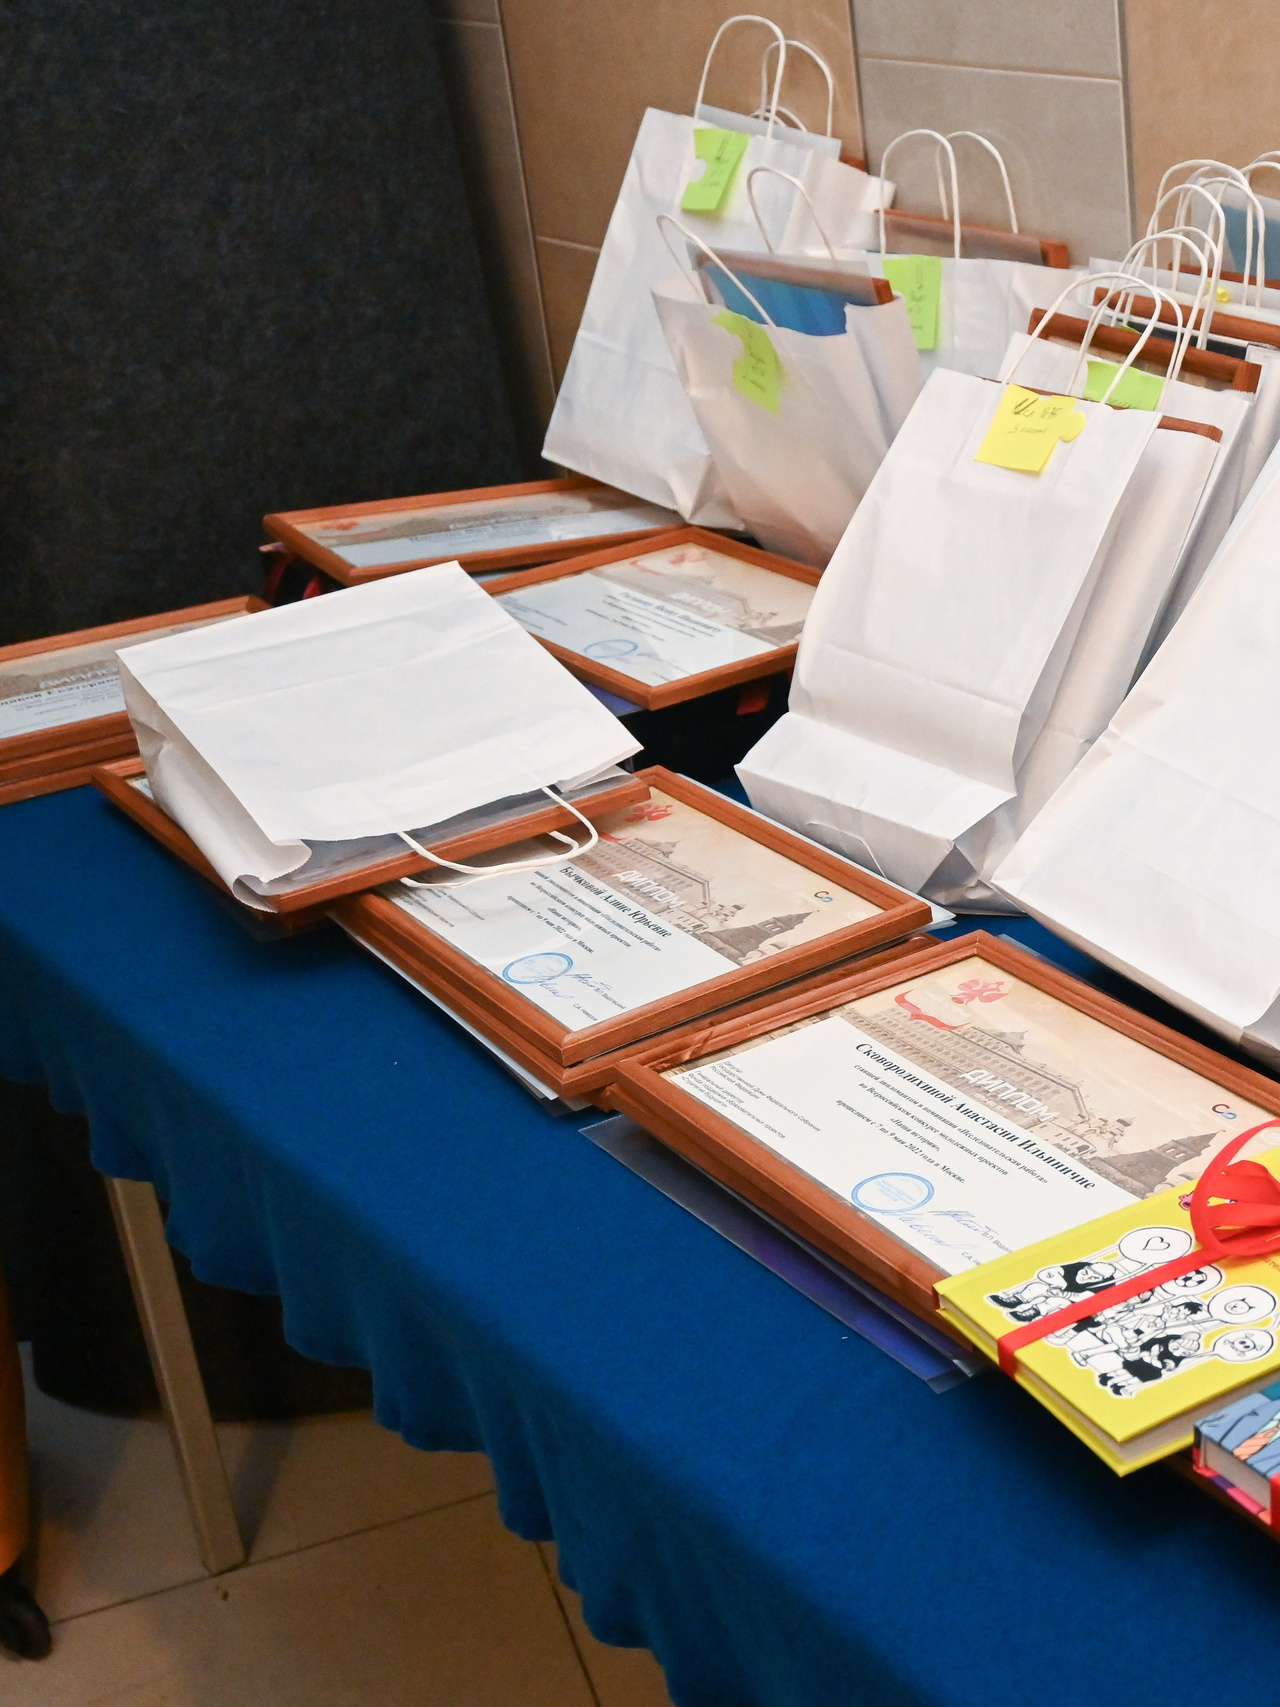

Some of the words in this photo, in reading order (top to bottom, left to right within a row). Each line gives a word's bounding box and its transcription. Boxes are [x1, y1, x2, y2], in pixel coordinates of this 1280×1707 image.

[559, 866, 607, 895] Бычковой
[600, 894, 631, 913] Алине
[628, 910, 672, 937] Юрьевне
[612, 870, 688, 910] ДИПЛОМ
[854, 1064, 881, 1081] ставшей
[877, 1080, 919, 1105] дипломантом
[922, 1106, 958, 1128] номинации
[957, 1128, 1021, 1166] «Исследовательская
[1018, 1165, 1048, 1183] работа»
[856, 1043, 956, 1103] Сковородихиной
[950, 1103, 1019, 1142] Анастасии
[1018, 1139, 1095, 1188] Ильиничне
[866, 1087, 911, 1116] Всероссийском
[909, 1114, 939, 1133] конкурсе
[977, 1156, 1008, 1175] проектов
[889, 1118, 912, 1132] «Наша
[958, 1068, 1061, 1124] ДИПЛОМ
[836, 1099, 872, 1122] прошедшем
[893, 1136, 906, 1145] мая
[904, 1143, 923, 1154] 2022
[919, 1153, 935, 1163] года
[941, 1165, 965, 1183] Москве.
